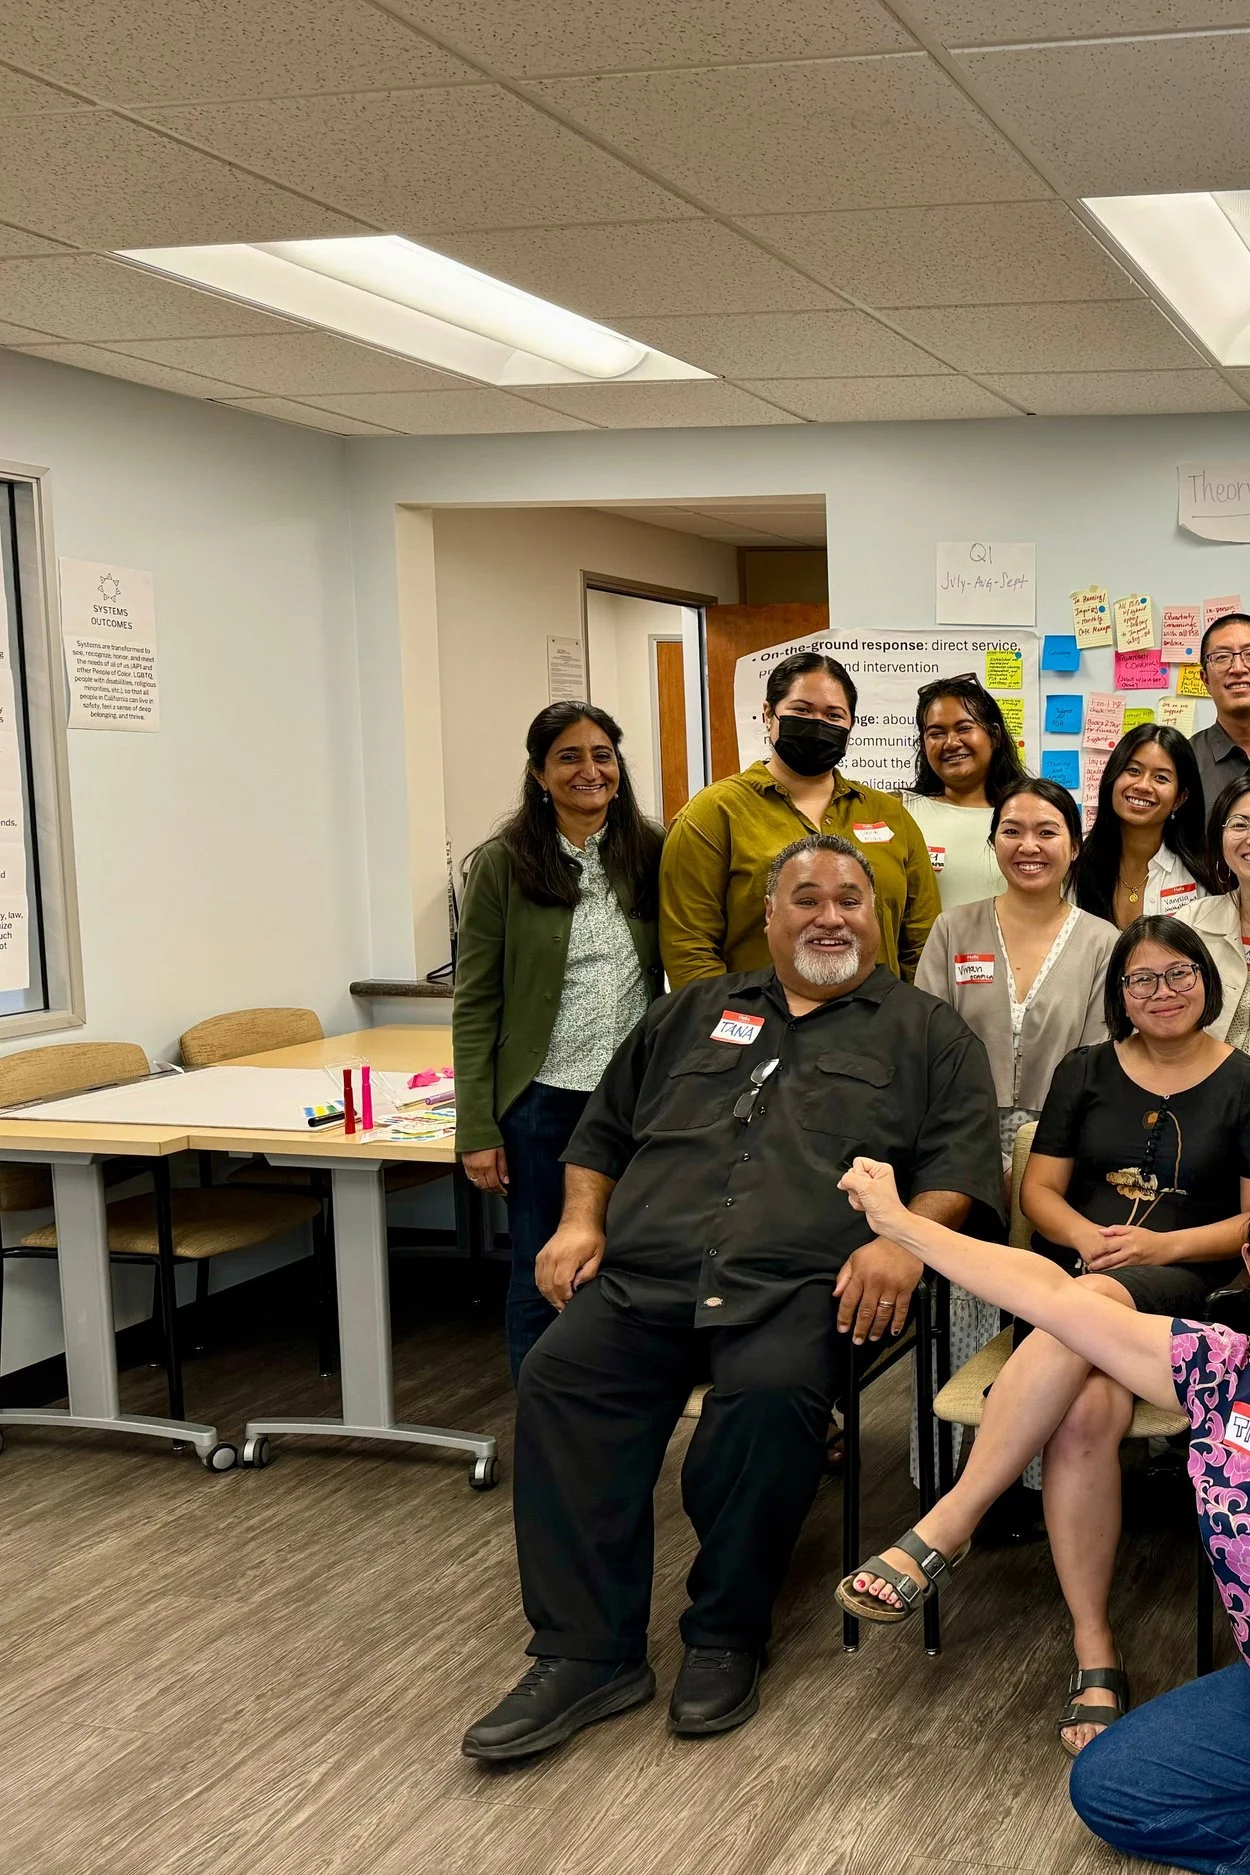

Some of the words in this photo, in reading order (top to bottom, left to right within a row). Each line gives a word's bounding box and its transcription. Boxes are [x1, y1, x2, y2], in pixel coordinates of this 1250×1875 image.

[969, 542, 993, 564] Q1
[93, 604, 129, 617] SYSTEMS
[91, 616, 133, 630] OUTCOMES
[76, 640, 101, 649] Systems
[111, 644, 144, 653] transformed
[760, 639, 858, 662] On-the-ground
[862, 640, 928, 653] response:
[931, 640, 968, 651] direct
[92, 667, 110, 676] People
[844, 661, 860, 673] nd
[863, 661, 939, 673] intervention
[90, 711, 117, 719] belonging,
[883, 714, 915, 725] abou
[848, 736, 920, 747] communiti
[851, 757, 888, 768] about
[891, 758, 911, 768] the
[860, 779, 911, 790] olidarity
[720, 1021, 754, 1041] TANA
